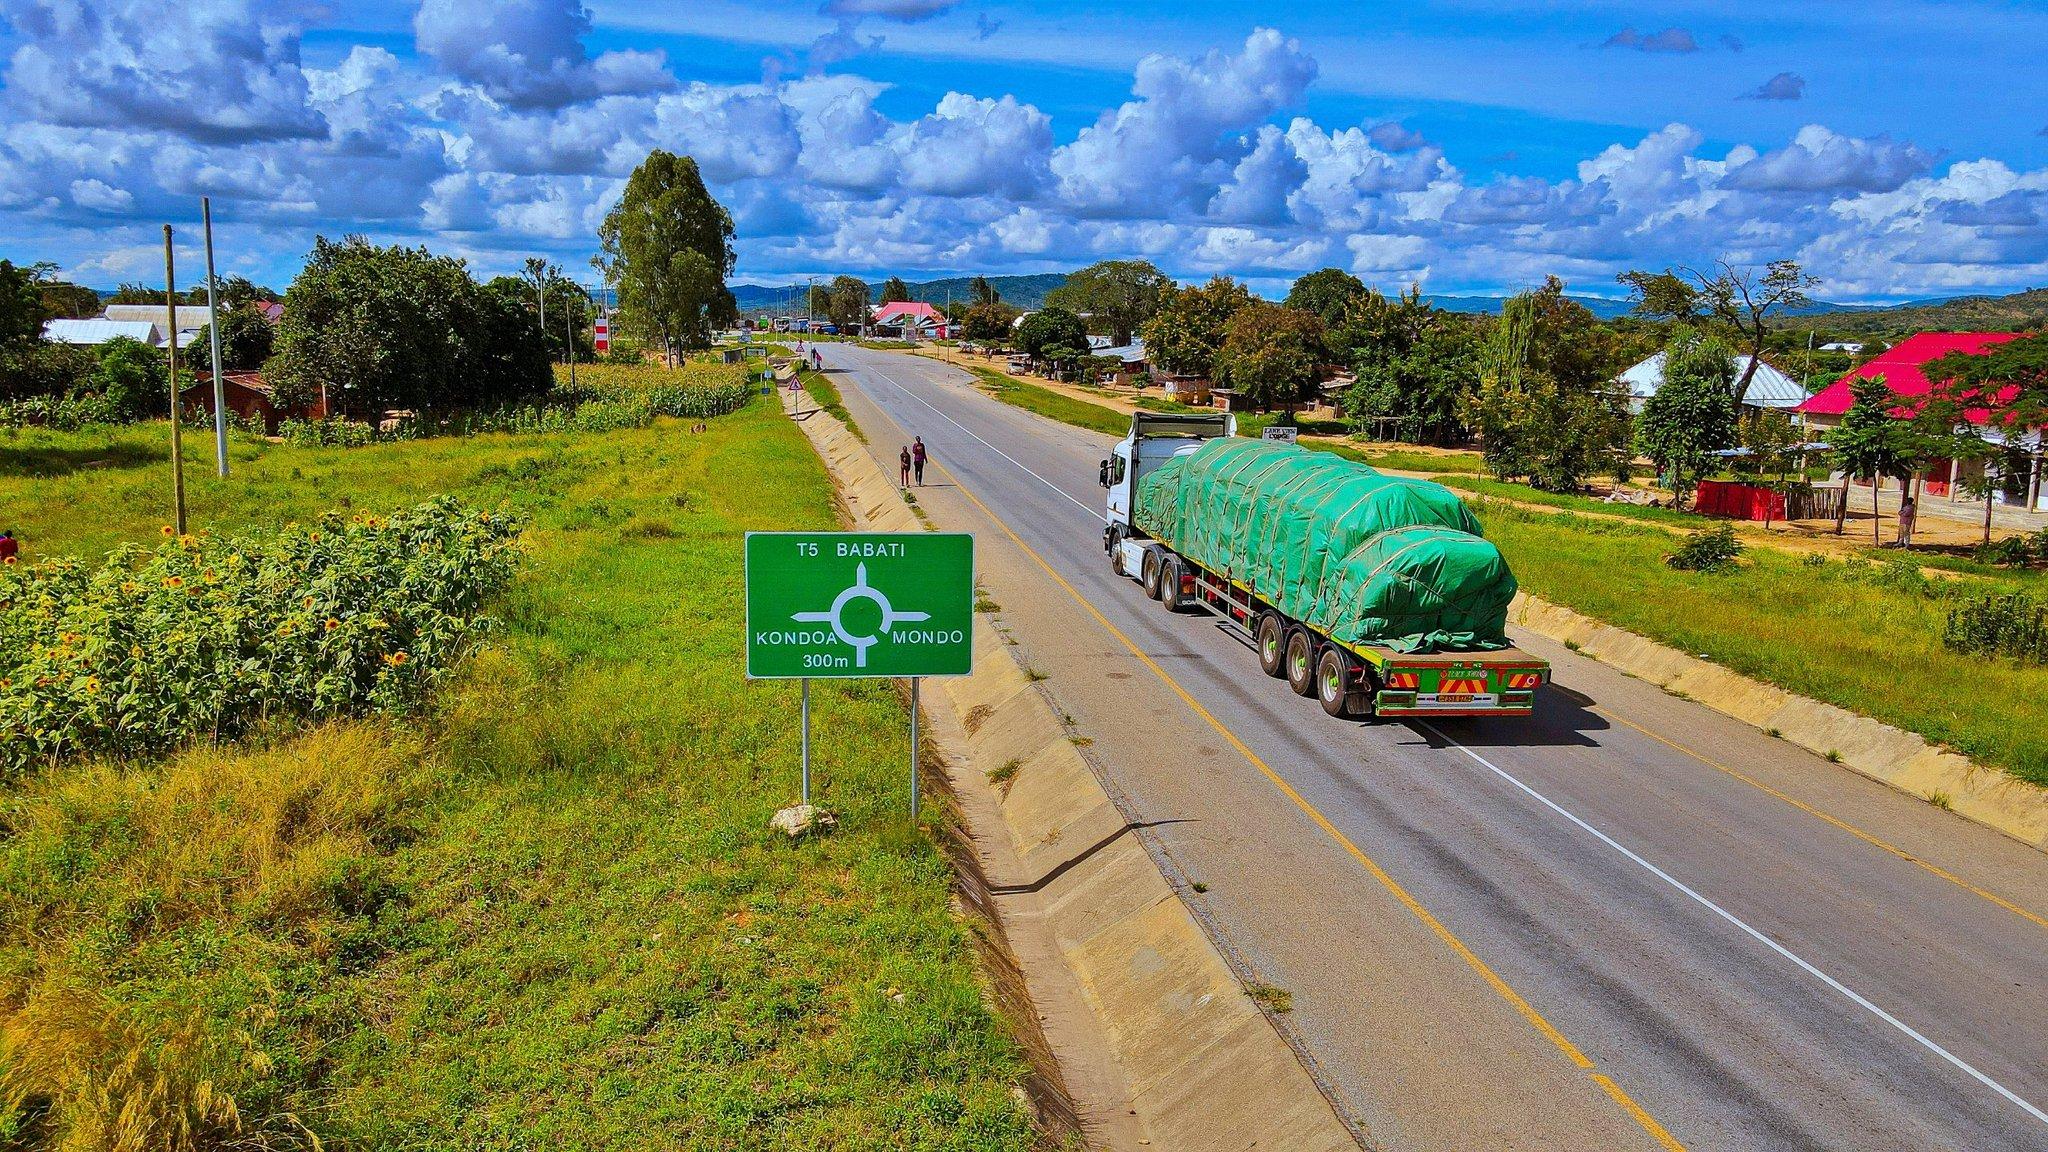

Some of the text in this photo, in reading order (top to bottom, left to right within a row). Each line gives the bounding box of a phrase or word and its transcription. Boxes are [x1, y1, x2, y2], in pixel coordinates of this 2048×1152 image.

[797, 543, 905, 557] T5 BABATI
[756, 631, 838, 645] KONDOA
[892, 630, 963, 644] MONDO
